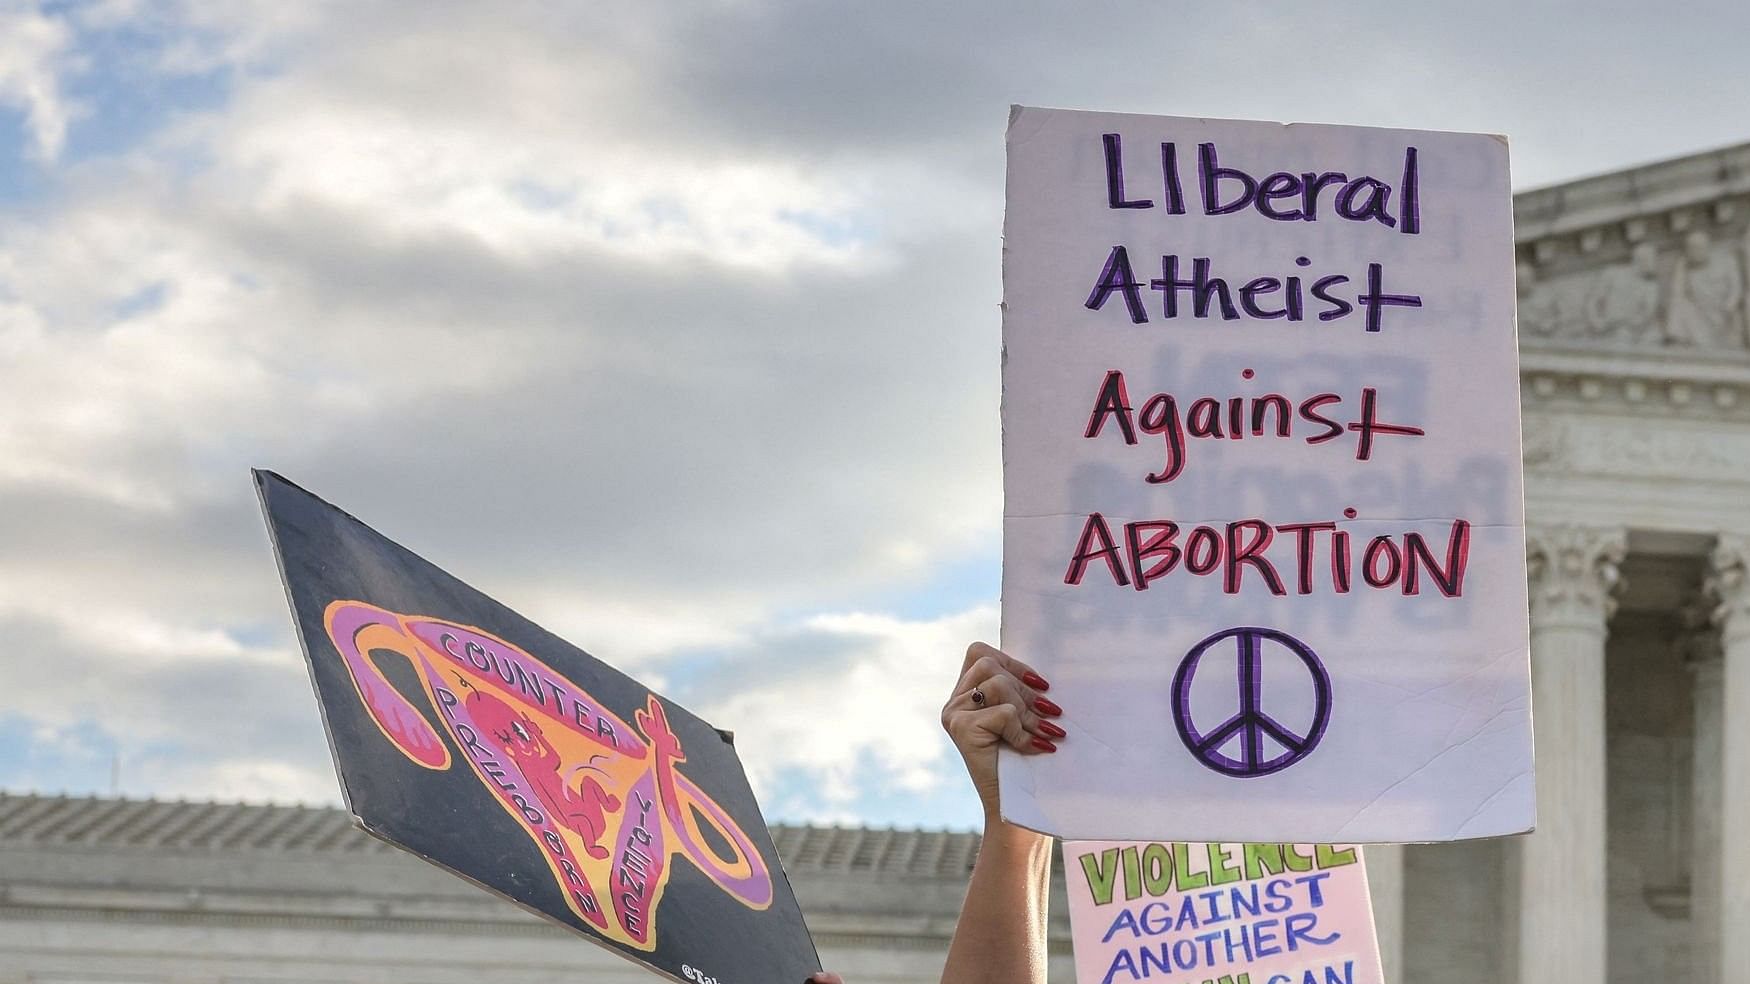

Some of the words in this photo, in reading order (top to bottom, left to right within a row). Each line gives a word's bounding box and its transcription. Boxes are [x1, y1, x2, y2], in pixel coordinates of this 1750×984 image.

[1084, 245, 1423, 332] Atheist
[1084, 369, 1425, 484] Against
[440, 632, 621, 748] COUNTER
[1101, 872, 1331, 944] AGAINST
